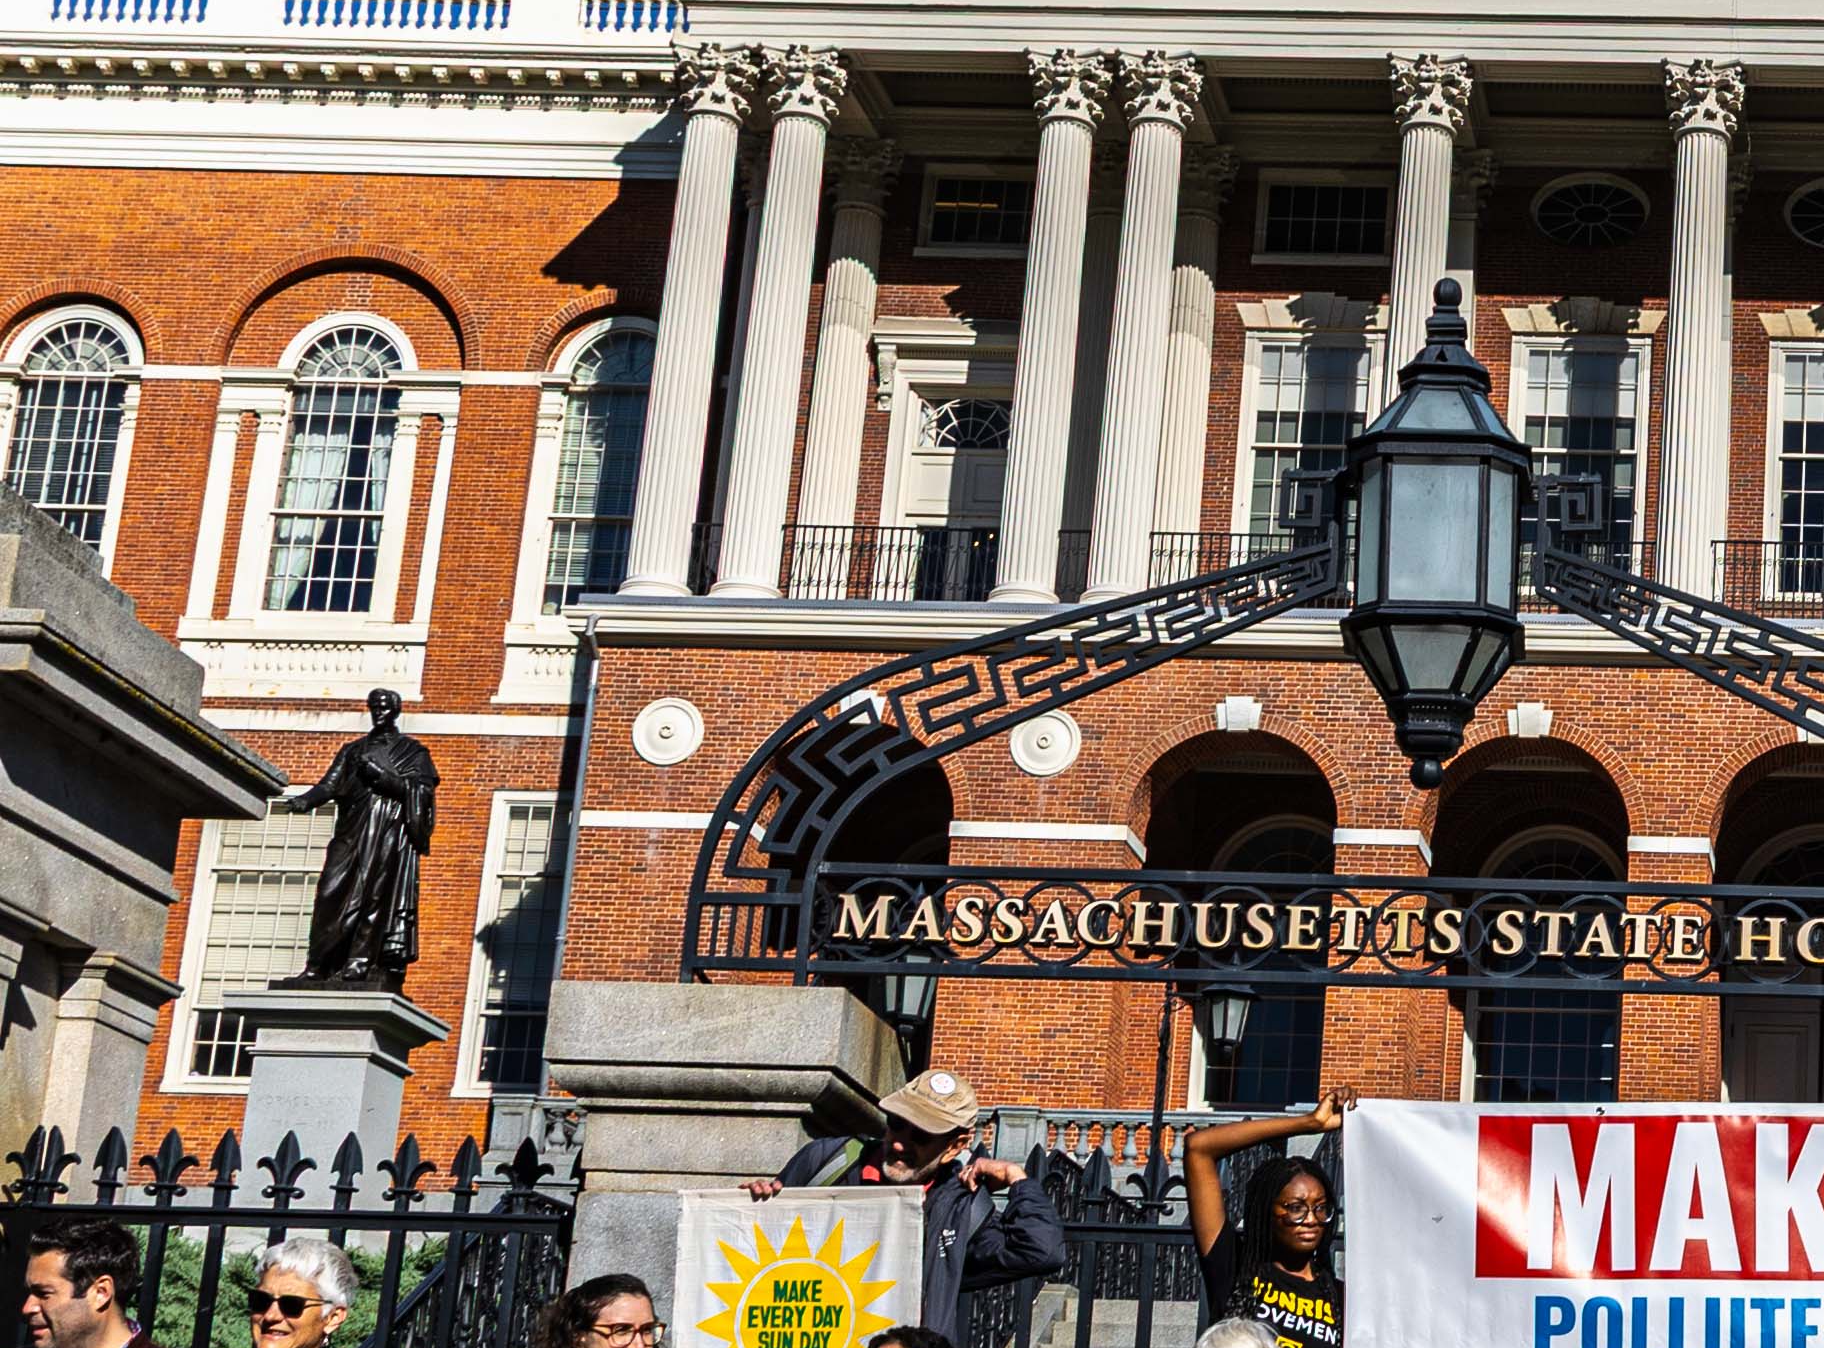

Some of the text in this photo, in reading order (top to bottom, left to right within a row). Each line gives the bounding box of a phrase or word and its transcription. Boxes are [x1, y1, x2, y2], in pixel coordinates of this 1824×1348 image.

[832, 893, 1464, 954] MASSACHUSETTS
[1491, 908, 1706, 961] STATE
[773, 1279, 823, 1303] MAKE
[747, 1305, 844, 1329] EVERY DAY
